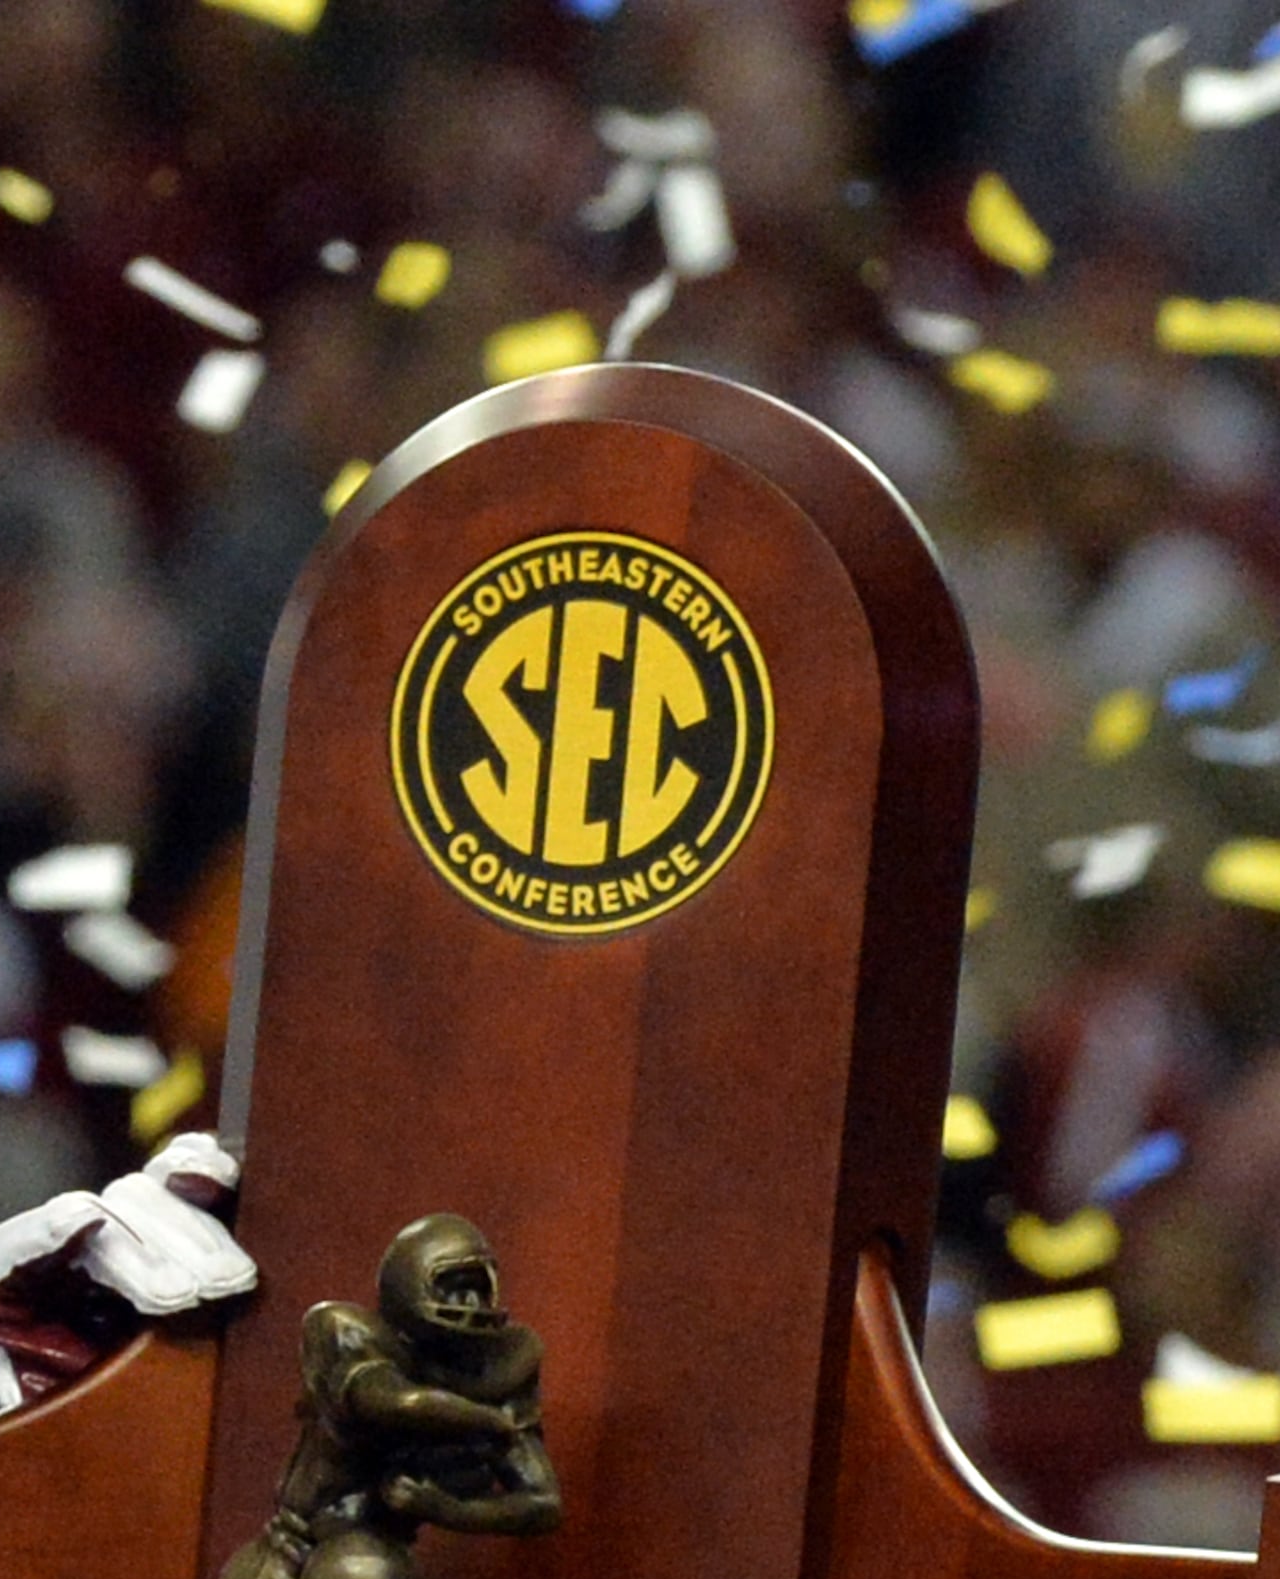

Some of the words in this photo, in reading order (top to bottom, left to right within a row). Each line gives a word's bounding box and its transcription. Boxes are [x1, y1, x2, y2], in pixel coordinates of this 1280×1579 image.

[452, 549, 733, 653] SOUTHEASTERN
[460, 598, 708, 867] SEC
[448, 832, 701, 917] CONFERENCE
